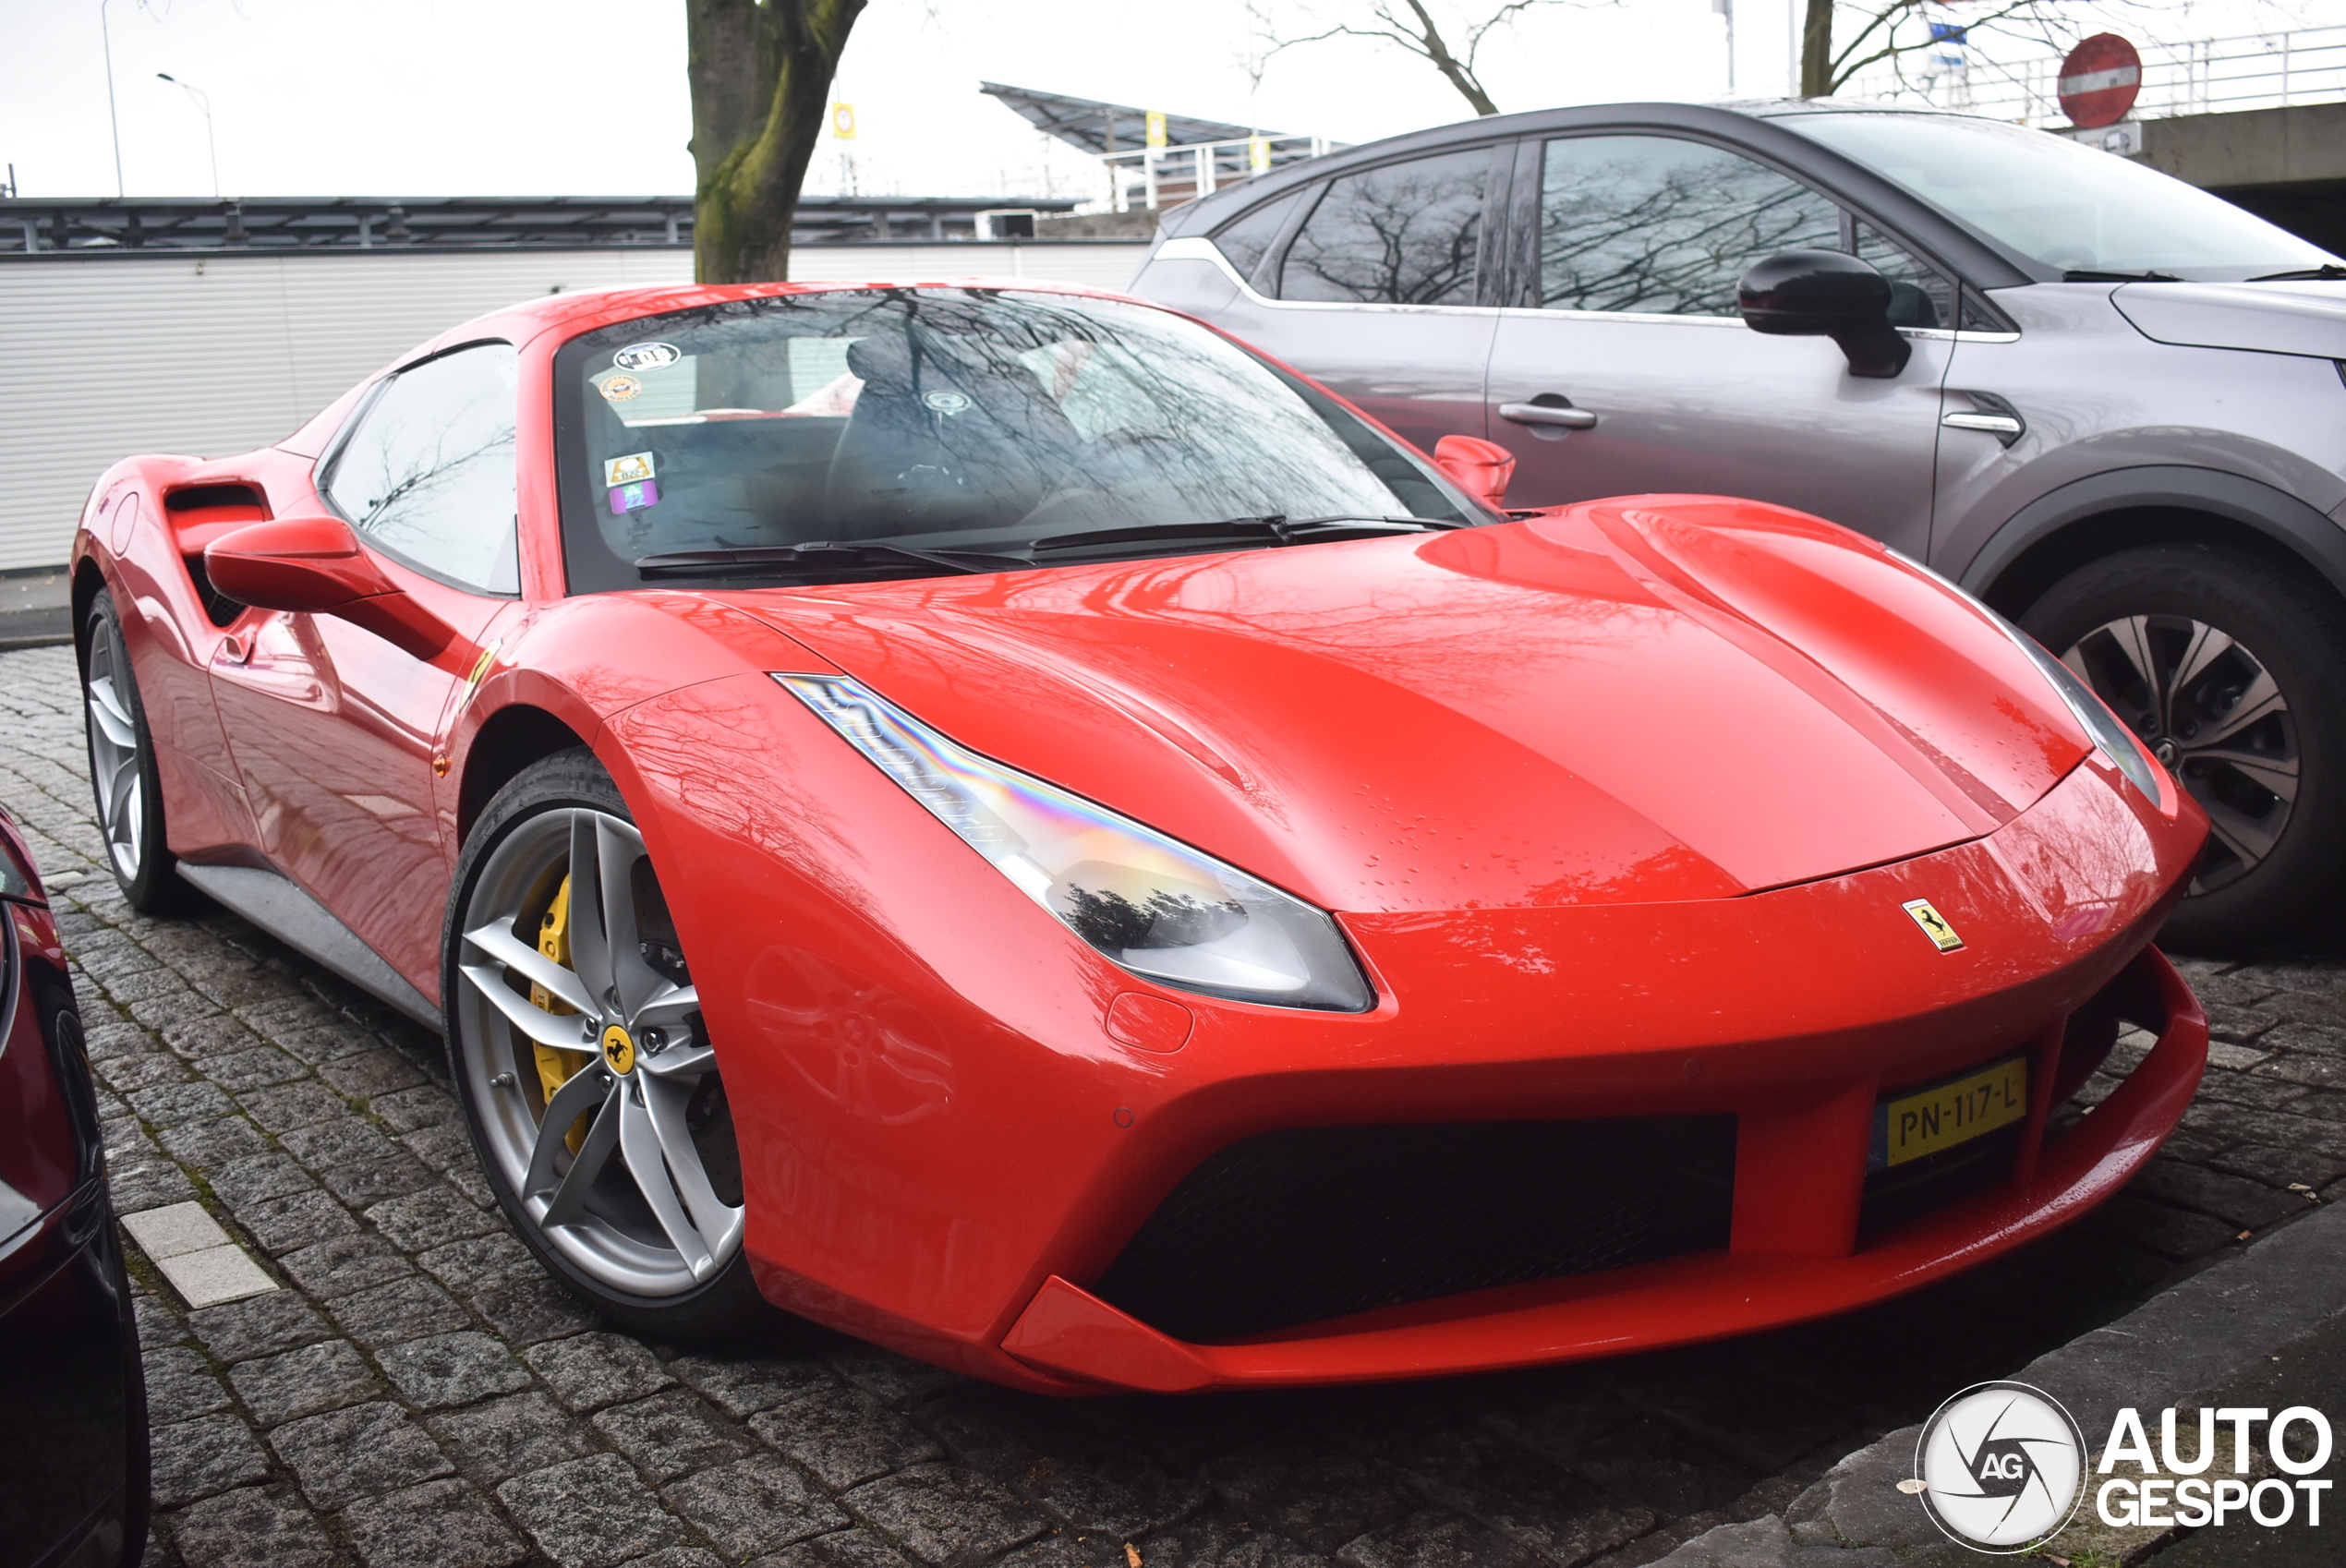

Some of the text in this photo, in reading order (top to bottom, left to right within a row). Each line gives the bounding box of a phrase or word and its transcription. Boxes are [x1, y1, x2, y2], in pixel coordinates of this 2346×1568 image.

[625, 494, 647, 509] 22
[1900, 1076, 2017, 1147] PN-117-L
[1868, 1149, 1881, 1162] NL
